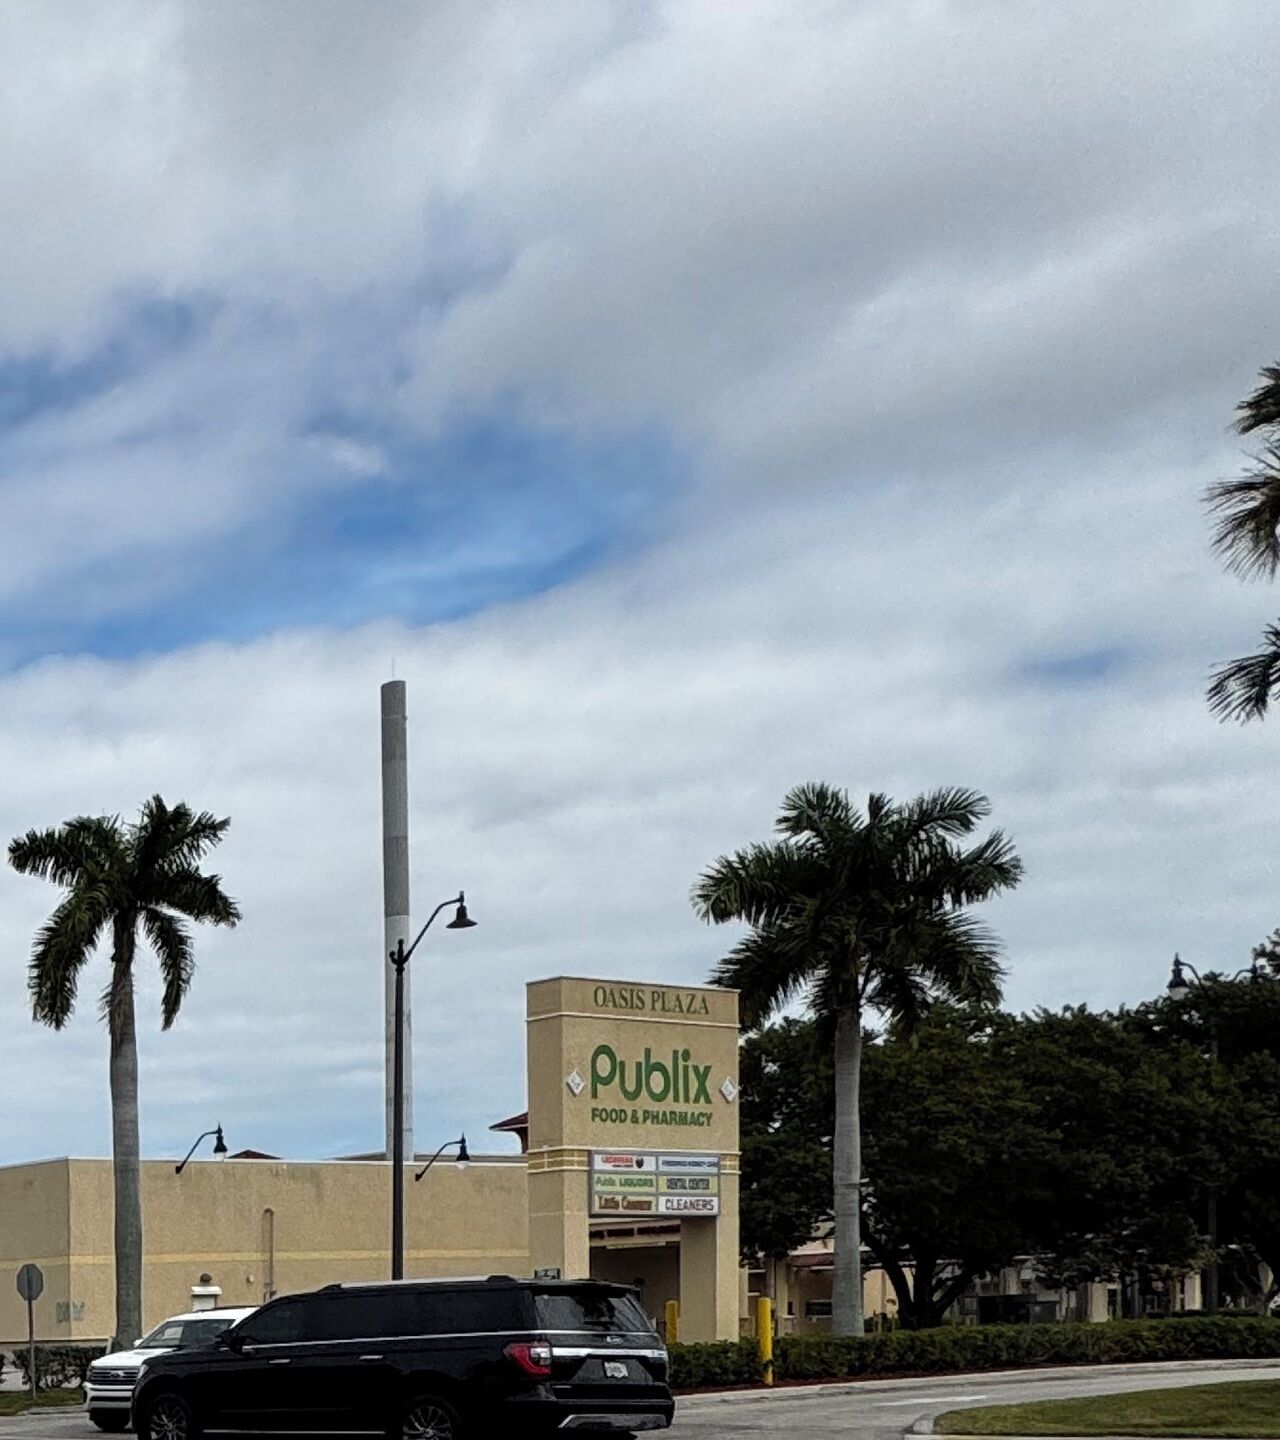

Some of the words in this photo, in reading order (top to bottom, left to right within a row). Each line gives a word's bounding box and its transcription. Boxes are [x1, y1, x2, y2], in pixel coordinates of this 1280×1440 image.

[594, 986, 646, 1012] OASIS
[651, 991, 710, 1016] PLAZA
[591, 1044, 713, 1105] Publix
[591, 1107, 628, 1124] FOOD
[630, 1109, 640, 1125] &
[642, 1109, 714, 1127] PHARMACY
[665, 1198, 715, 1212] CLEANERS
